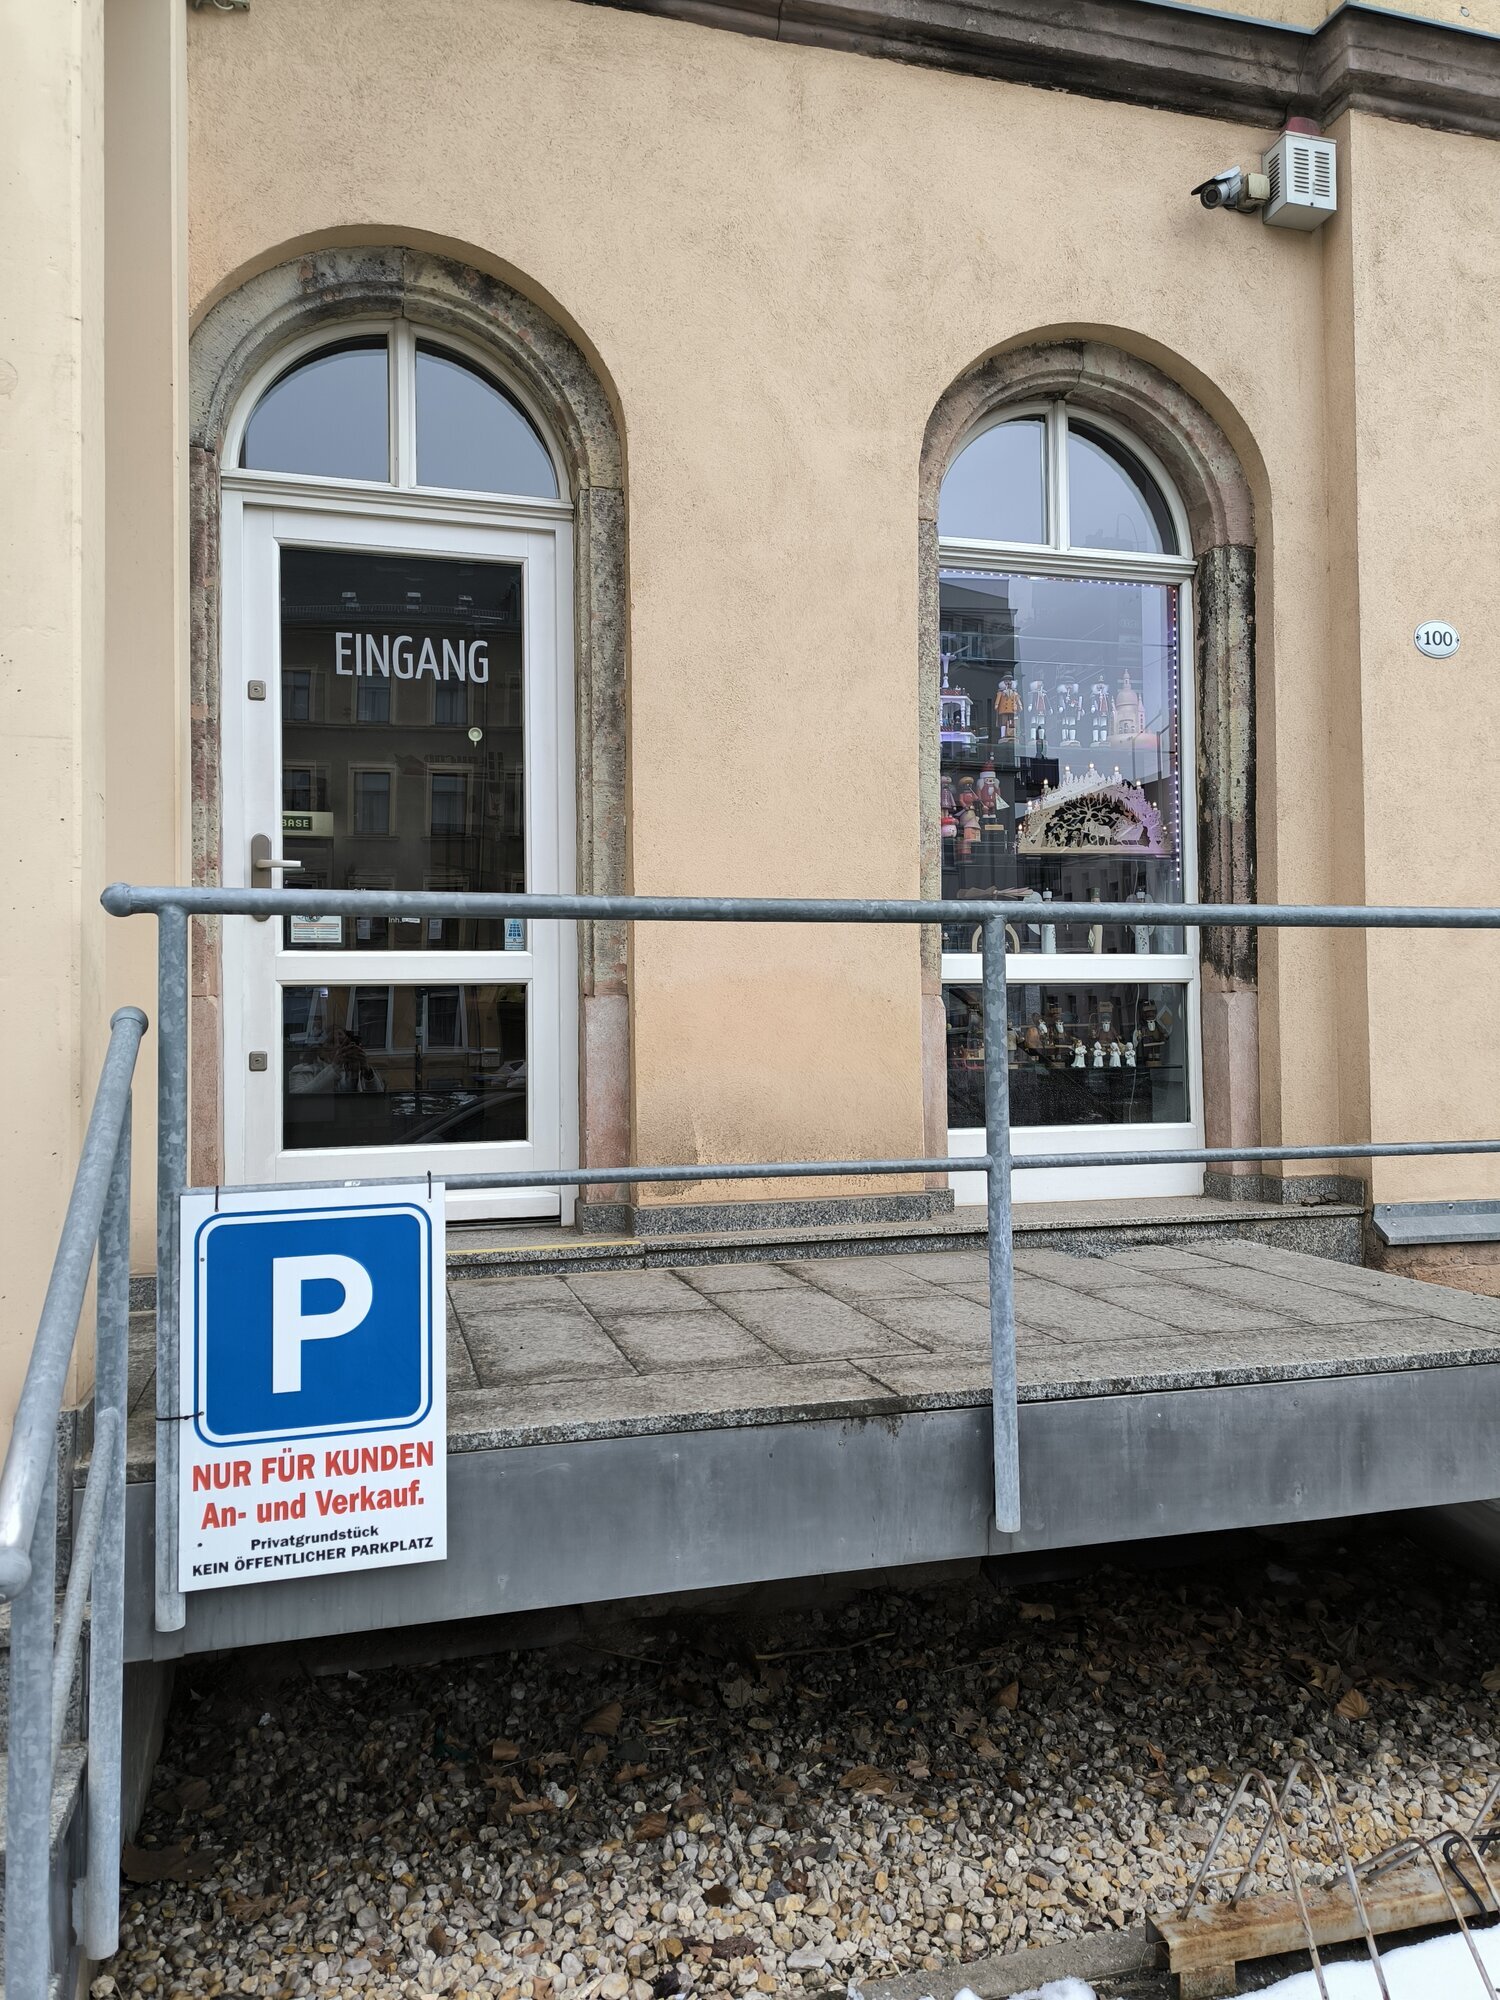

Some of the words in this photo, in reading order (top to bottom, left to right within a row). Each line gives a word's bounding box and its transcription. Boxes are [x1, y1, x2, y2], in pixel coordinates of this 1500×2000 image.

[335, 631, 489, 684] EINGANG
[1424, 630, 1453, 647] 100
[273, 1254, 373, 1394] P
[192, 1460, 252, 1492] NUR
[261, 1447, 315, 1485] FÜR
[325, 1441, 434, 1477] KUNDEN
[200, 1502, 247, 1530] An-
[256, 1492, 306, 1524] und
[315, 1479, 424, 1517] Verkauf.
[192, 1561, 229, 1577] KEIN
[234, 1547, 346, 1571] ÖFFENTLICHER
[351, 1536, 434, 1557] PARKPLATZ
[250, 1525, 379, 1551] Privatgrundstück
